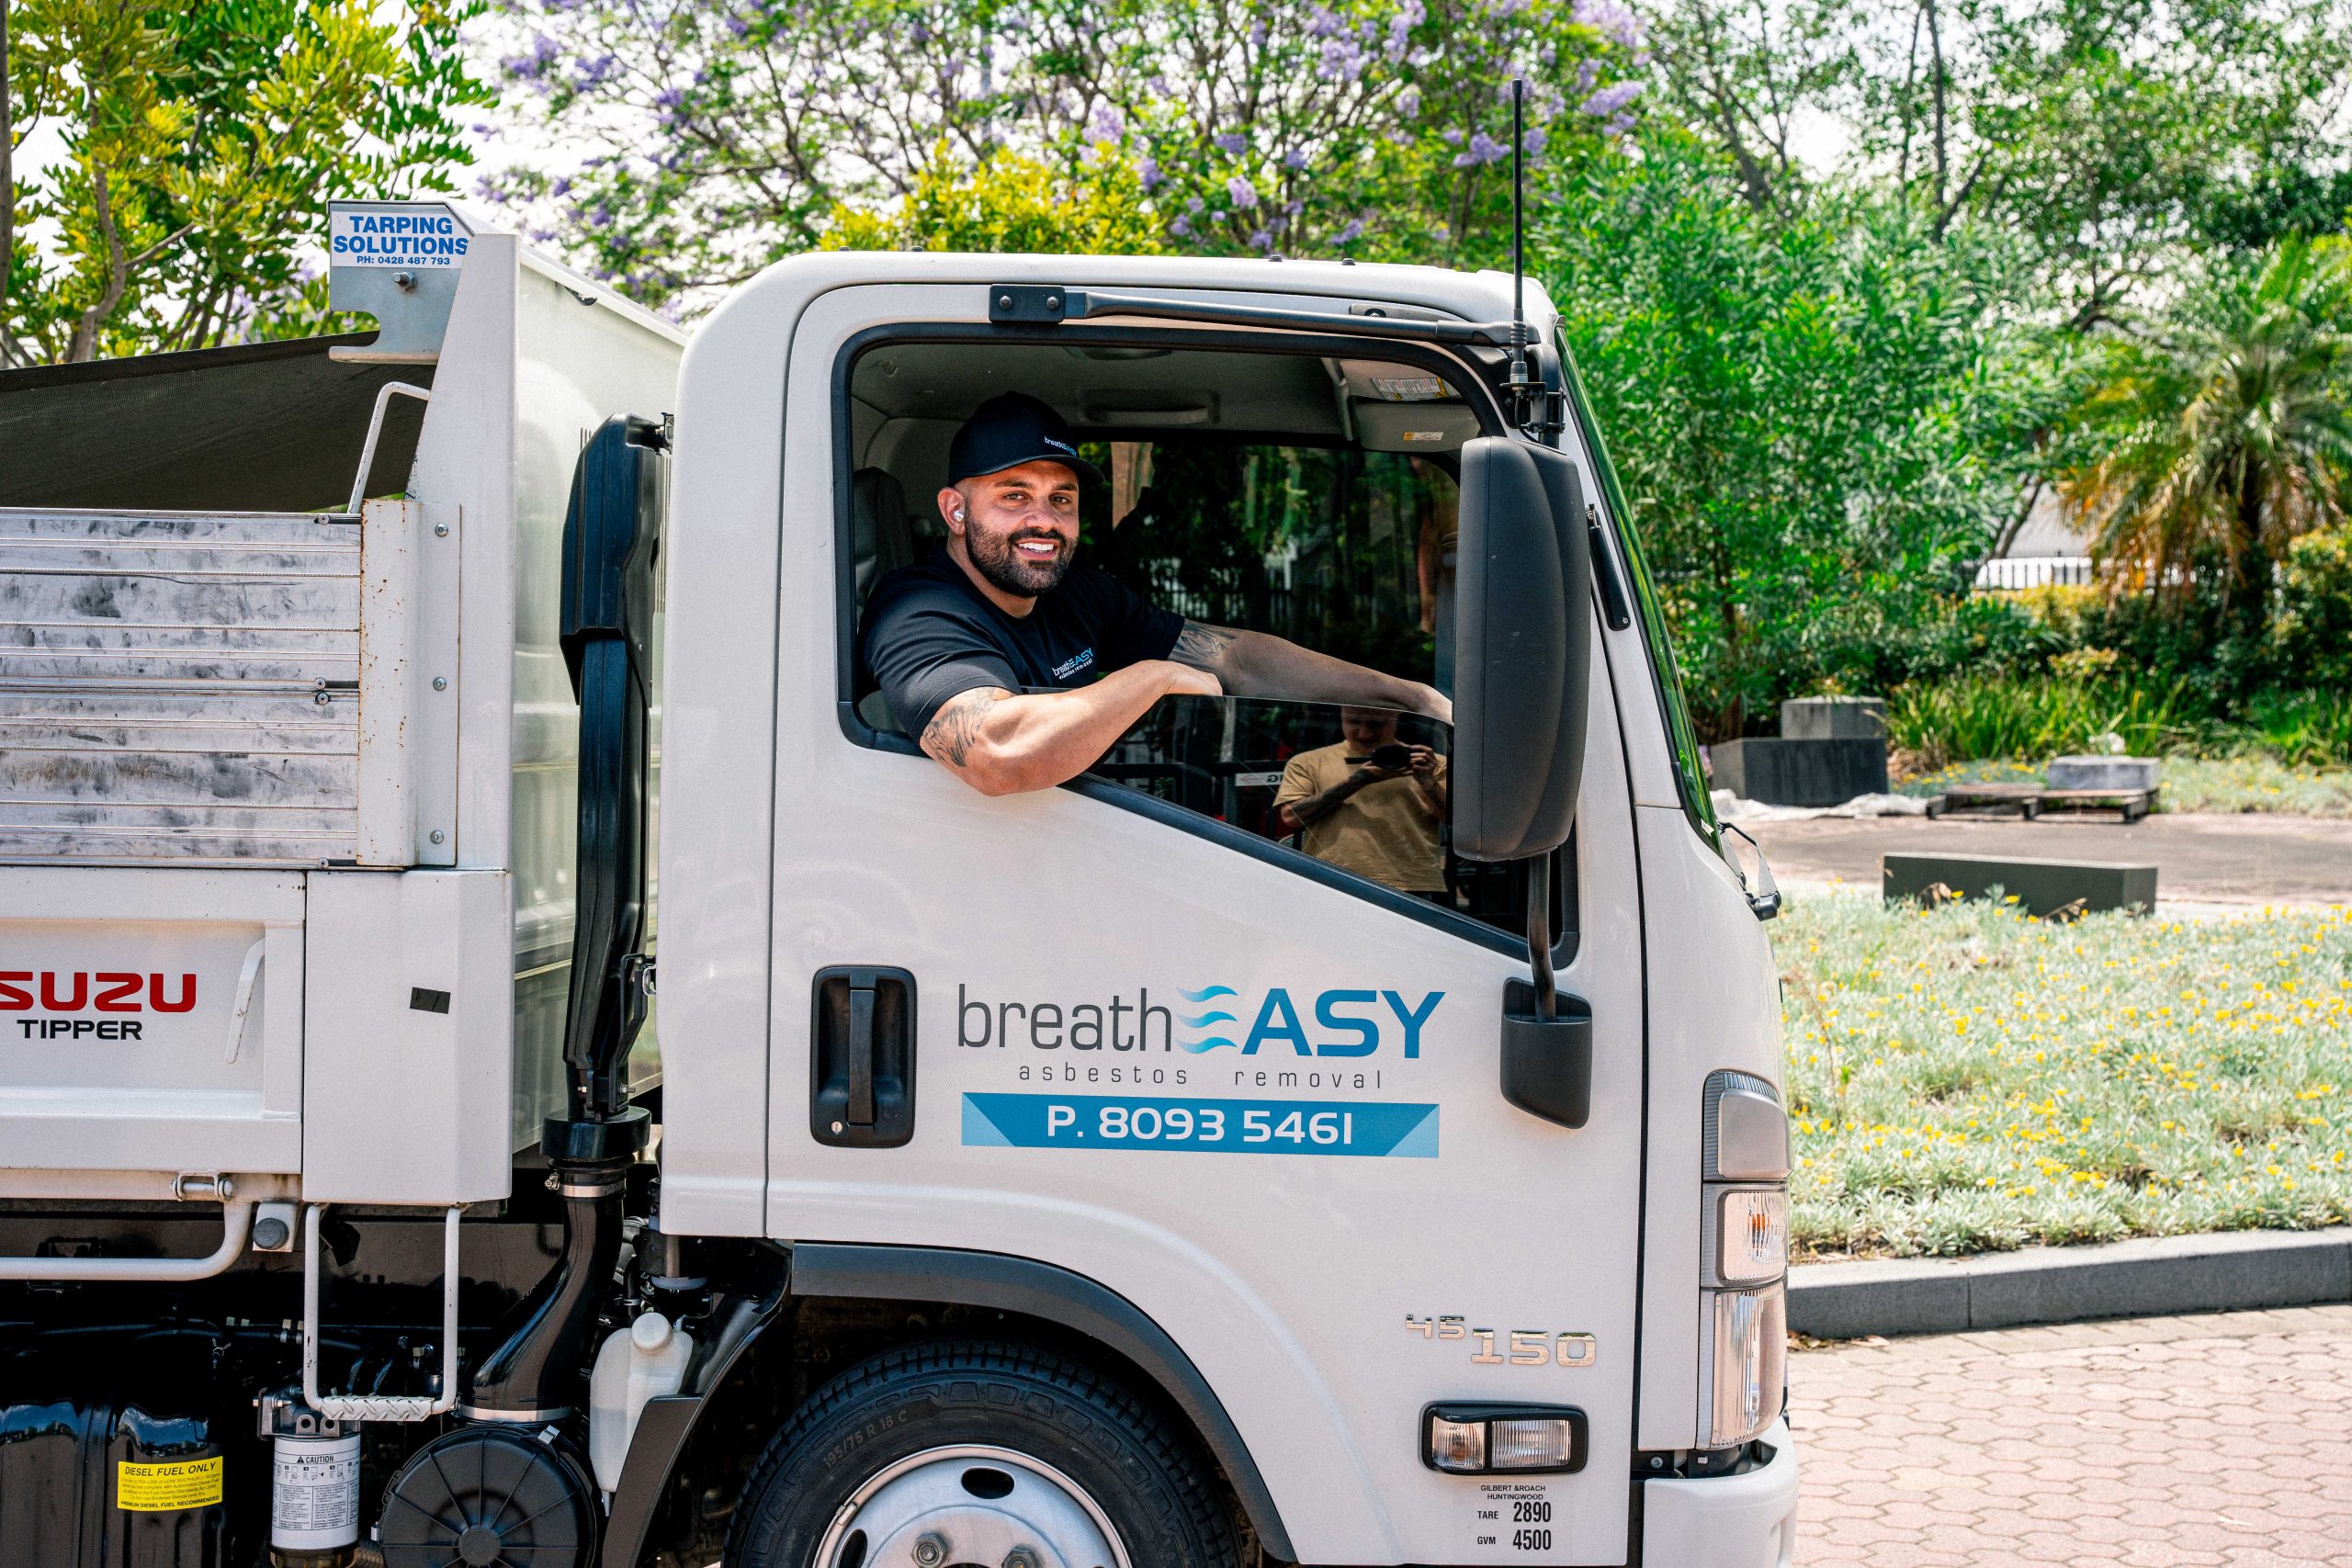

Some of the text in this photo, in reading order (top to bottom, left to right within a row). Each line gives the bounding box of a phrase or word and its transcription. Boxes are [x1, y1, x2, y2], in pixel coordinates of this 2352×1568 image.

[350, 216, 452, 234] TARPING
[334, 235, 469, 255] SOLUTIONS
[17, 1019, 142, 1040] TIPPER
[1019, 1062, 1382, 1089] asbestos removal
[1047, 1105, 1352, 1145] P. 8093 5461
[1406, 1314, 1465, 1339] 45
[1470, 1328, 1596, 1367] 150
[866, 1423, 876, 1438] R
[879, 1416, 894, 1430] 16
[898, 1410, 908, 1422] C
[125, 1462, 216, 1477] DIESEL FUEL ONLY
[305, 1455, 334, 1464] CAUTION
[177, 1495, 220, 1506] RECOMMENDED
[1477, 1501, 1551, 1523] TARE 2890
[1477, 1529, 1551, 1550] GVM 4500
